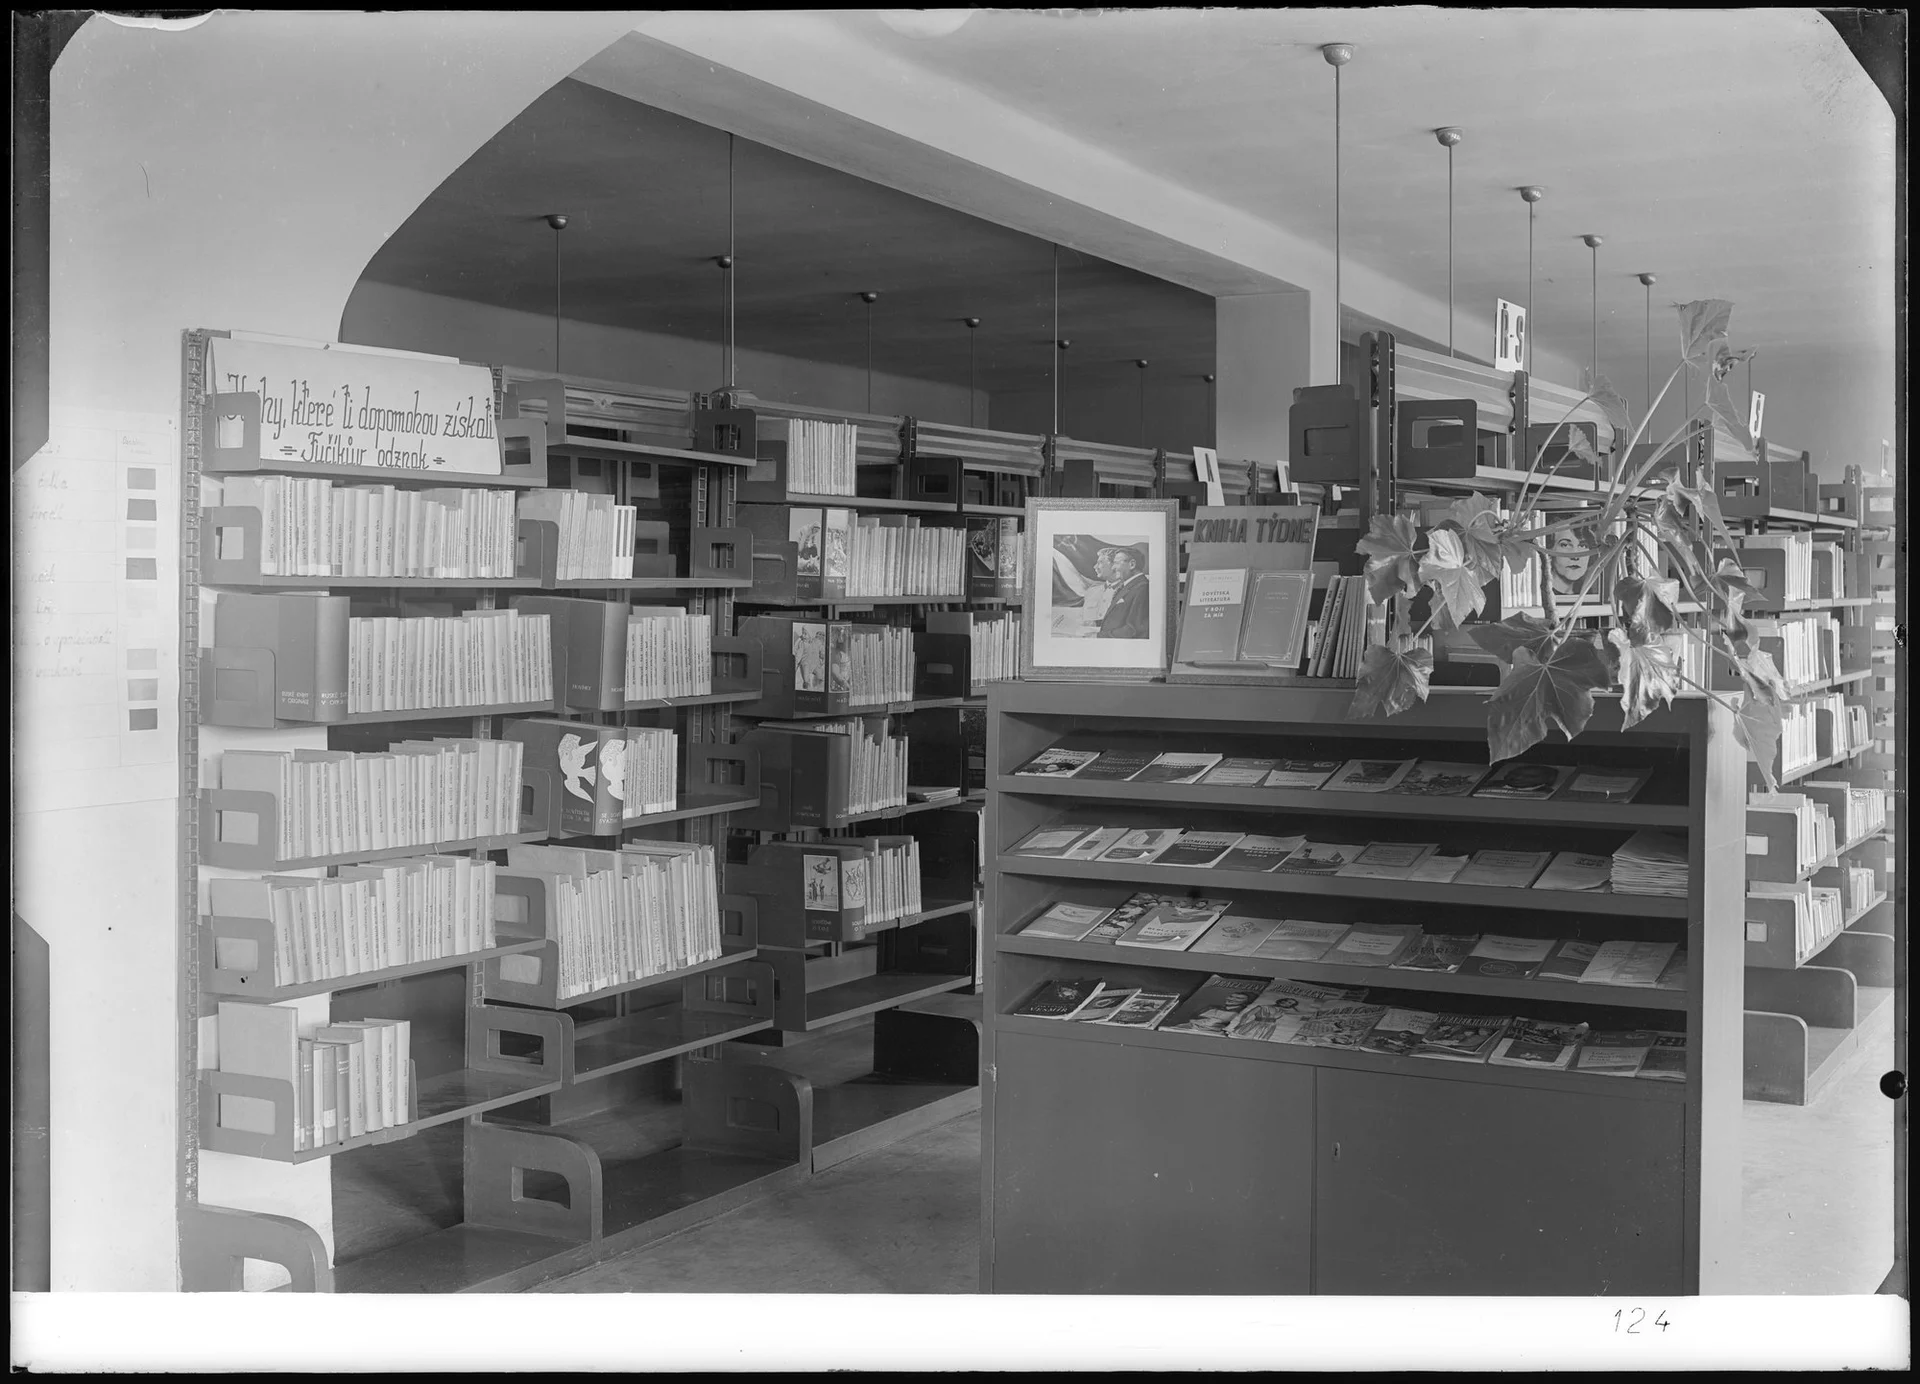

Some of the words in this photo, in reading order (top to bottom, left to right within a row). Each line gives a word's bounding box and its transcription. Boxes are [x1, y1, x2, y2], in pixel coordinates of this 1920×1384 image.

[227, 372, 286, 440] Khy,
[291, 379, 336, 427] které
[341, 384, 354, 430] ti
[358, 385, 439, 450] dopomohou
[377, 436, 430, 470] odznak
[1193, 518, 1248, 544] KNIHA
[1256, 511, 1314, 544] TÝDNE
[1613, 1306, 1671, 1334] 124
